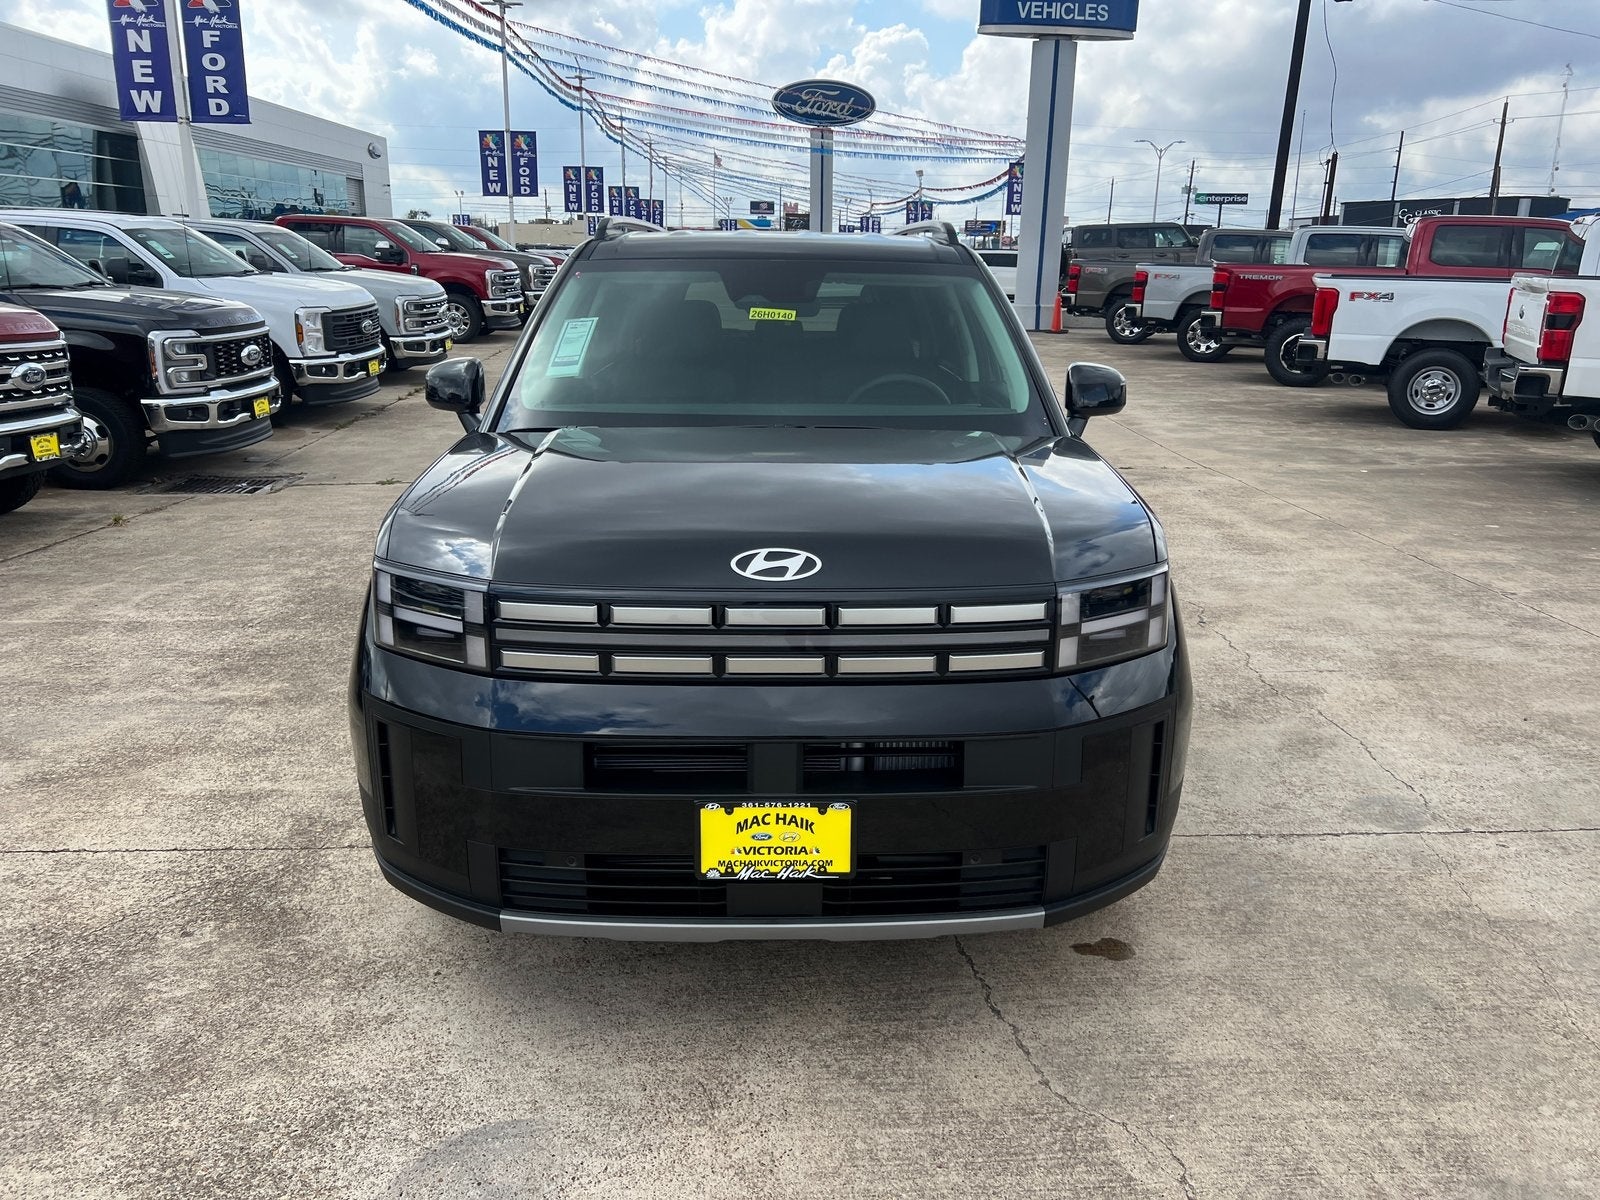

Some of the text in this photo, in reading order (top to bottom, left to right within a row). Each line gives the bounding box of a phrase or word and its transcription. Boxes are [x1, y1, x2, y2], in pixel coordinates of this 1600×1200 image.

[1017, 1, 1109, 21] VEHICLES
[126, 29, 162, 113] NEW
[201, 30, 229, 116] FORD
[795, 88, 855, 116] Ford
[487, 156, 501, 193] NEW
[519, 157, 531, 194] FORD
[568, 184, 578, 211] NEW
[590, 185, 599, 211] FORD
[1011, 184, 1021, 213] NEW
[1197, 194, 1247, 203] enterprise
[1239, 273, 1283, 281] TREMOR
[1349, 291, 1394, 301] FX4
[751, 310, 793, 319] 26H0140
[25, 370, 42, 382] Ford
[736, 813, 815, 834] MAC HAIK
[742, 846, 808, 855] VICTORIA
[737, 865, 816, 880] Mac Haik
